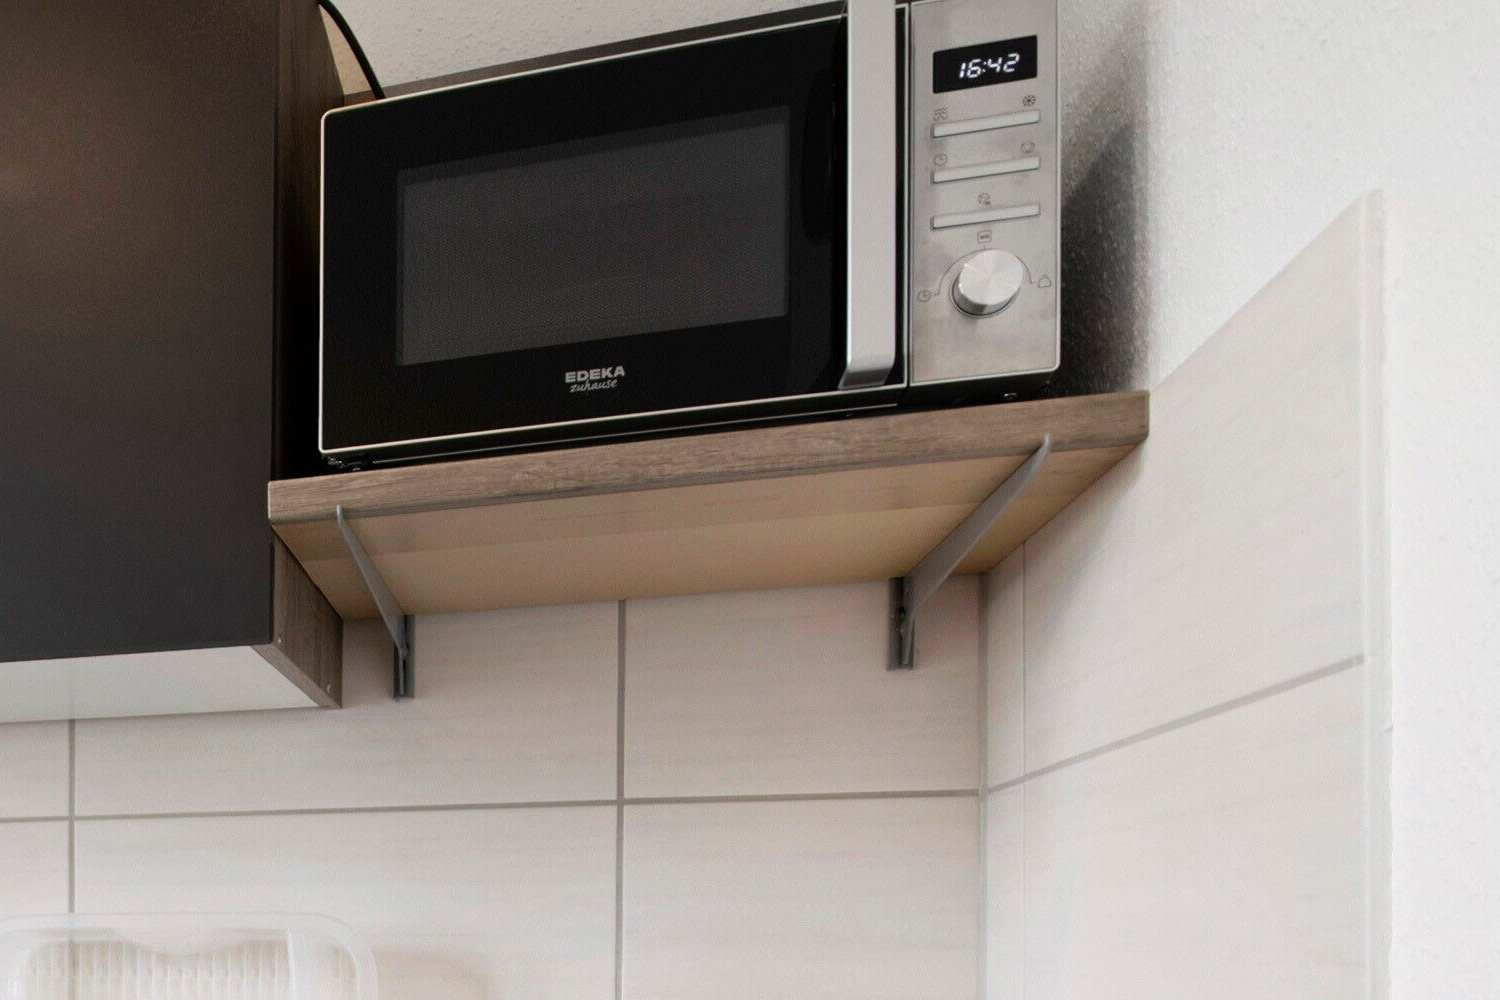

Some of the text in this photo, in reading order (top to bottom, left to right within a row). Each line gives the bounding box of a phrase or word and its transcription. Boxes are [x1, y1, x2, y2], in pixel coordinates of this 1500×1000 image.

[959, 52, 1020, 79] 16:42
[565, 365, 626, 383] EDEKA
[570, 379, 618, 393] zuhause
